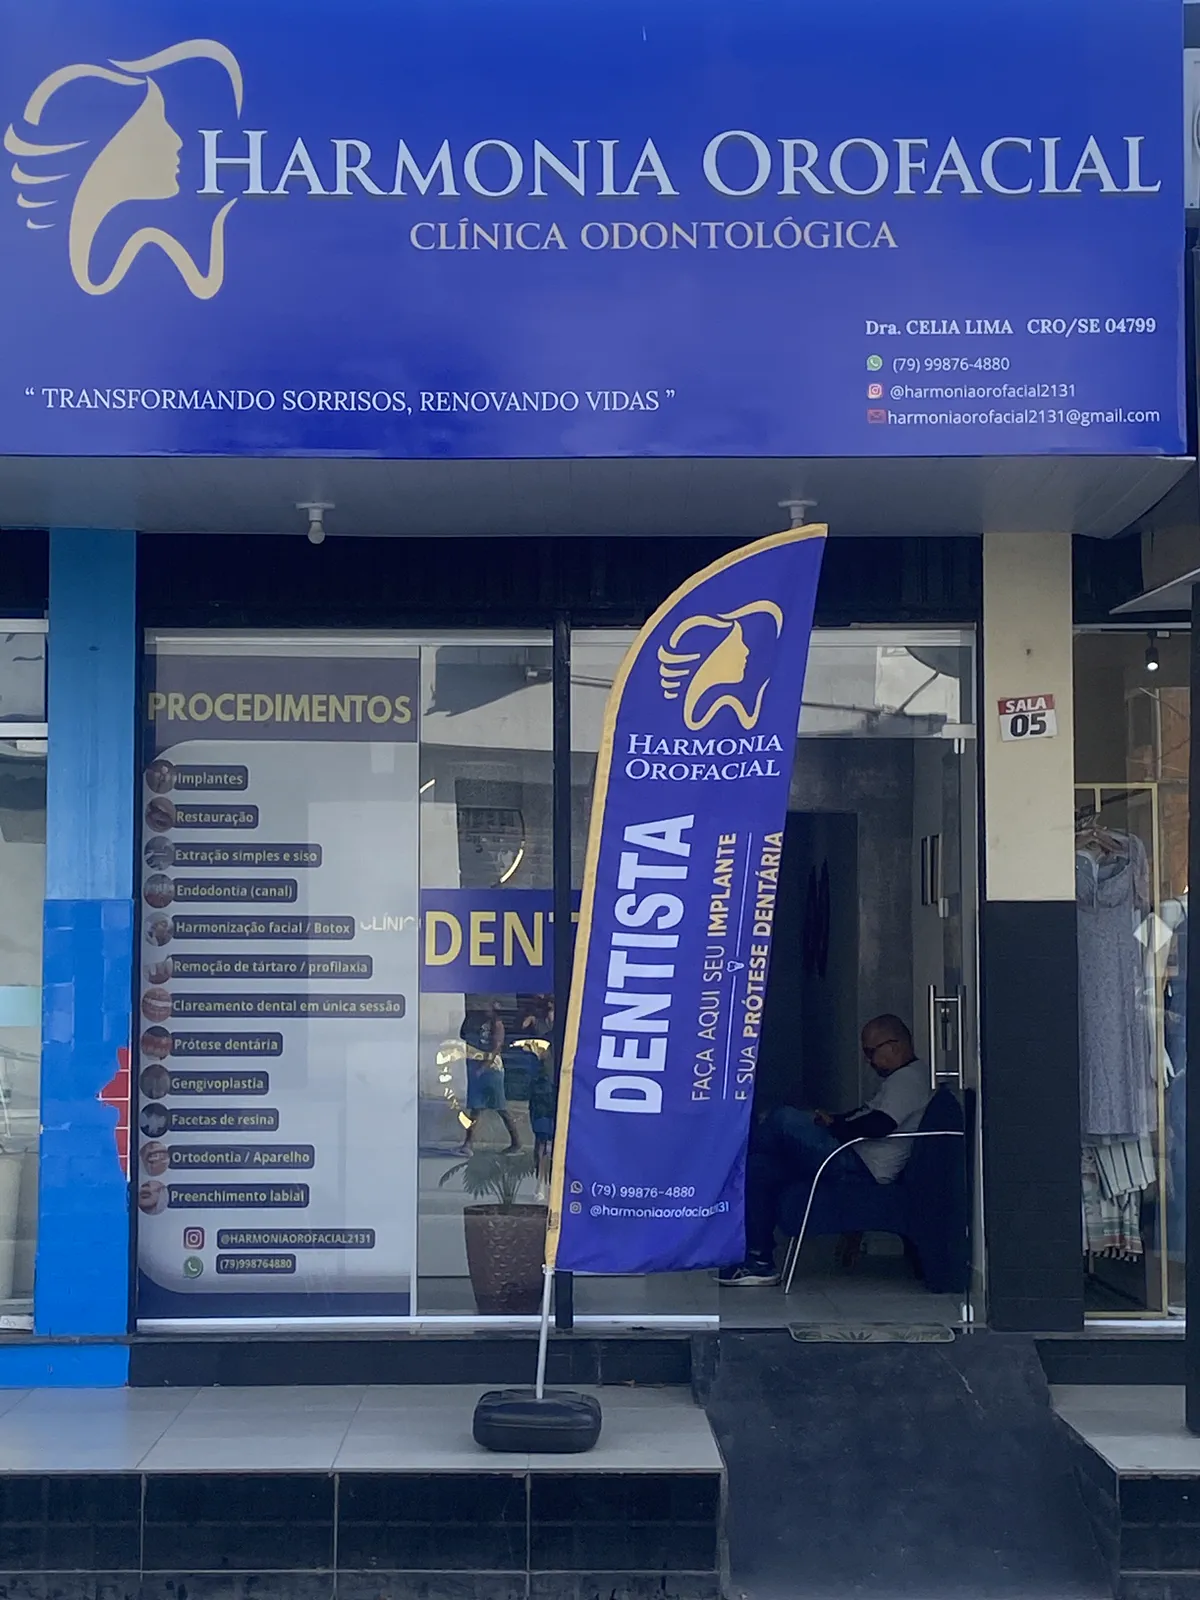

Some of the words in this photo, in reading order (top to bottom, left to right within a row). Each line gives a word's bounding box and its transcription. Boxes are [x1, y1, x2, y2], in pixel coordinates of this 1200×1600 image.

[196, 129, 679, 197] HARMONIA
[703, 130, 1161, 196] OROFACIAL
[410, 218, 568, 250] CLÍNICA
[581, 217, 898, 250] ODONTOLÓGICA
[865, 320, 901, 335] Dra.
[906, 320, 961, 335] CELIA
[965, 319, 1013, 335] LIMA
[1027, 318, 1100, 338] CRO/SE
[1105, 317, 1157, 334] 04799
[892, 357, 921, 373] (79)
[924, 357, 1010, 372] 99876-4880
[890, 384, 1076, 400] @harmoniaorofacial2131
[42, 388, 275, 412] TRANSFORMANDO
[282, 389, 413, 416] SORRISOS,
[419, 390, 578, 412] RENOVANDO
[586, 390, 660, 412] VIDAS
[888, 408, 1161, 426] harmoniaorofacial2131@gmail.com
[147, 692, 412, 724] PROCEDIMENTOS
[1005, 697, 1046, 713] SALA
[1010, 713, 1046, 737] 05
[627, 734, 783, 756] HARMONIA
[625, 758, 780, 781] OROFACIAL
[178, 771, 243, 787] Implantes
[176, 811, 254, 826] Restauração
[175, 849, 229, 863] Extração
[232, 849, 280, 864] simples
[283, 853, 290, 862] e
[293, 851, 317, 862] siso
[176, 884, 247, 897] Endodontia
[250, 884, 292, 898] (canal)
[707, 833, 736, 936] IMPLANTE
[753, 831, 783, 937] DENTÁRIA
[176, 921, 266, 936] Harmonização
[269, 921, 302, 934] facial
[314, 922, 350, 935] Botox
[174, 960, 231, 975] Remoção
[234, 960, 249, 972] de
[251, 960, 297, 973] tártaro
[308, 961, 368, 976] profilaxia
[595, 814, 694, 1114] DENTISTA
[703, 945, 725, 982] SEU
[741, 944, 768, 1038] PRÓTESE
[173, 1000, 253, 1012] Clareamento
[257, 1000, 297, 1012] dental
[300, 1003, 318, 1012] em
[323, 1000, 356, 1013] única
[360, 1001, 400, 1013] sessão
[698, 990, 720, 1040] AQUI
[174, 1038, 221, 1050] Prótese
[225, 1038, 278, 1050] dentária
[737, 1046, 757, 1084] SUA
[692, 1048, 716, 1101] FAÇA
[172, 1077, 264, 1092] Gengivoplastia
[172, 1114, 217, 1126] Facetas
[220, 1114, 234, 1126] de
[238, 1115, 274, 1126] resina
[172, 1151, 241, 1164] Ortodontia
[253, 1151, 310, 1165] Aparelho
[171, 1190, 266, 1202] Preenchimento
[270, 1190, 304, 1202] labial
[591, 1182, 616, 1198] (79)
[620, 1186, 695, 1198] 99876-4880
[221, 1234, 370, 1245] @HARMONIAOROFACIAL2131
[220, 1259, 292, 1270] (79)998764880
